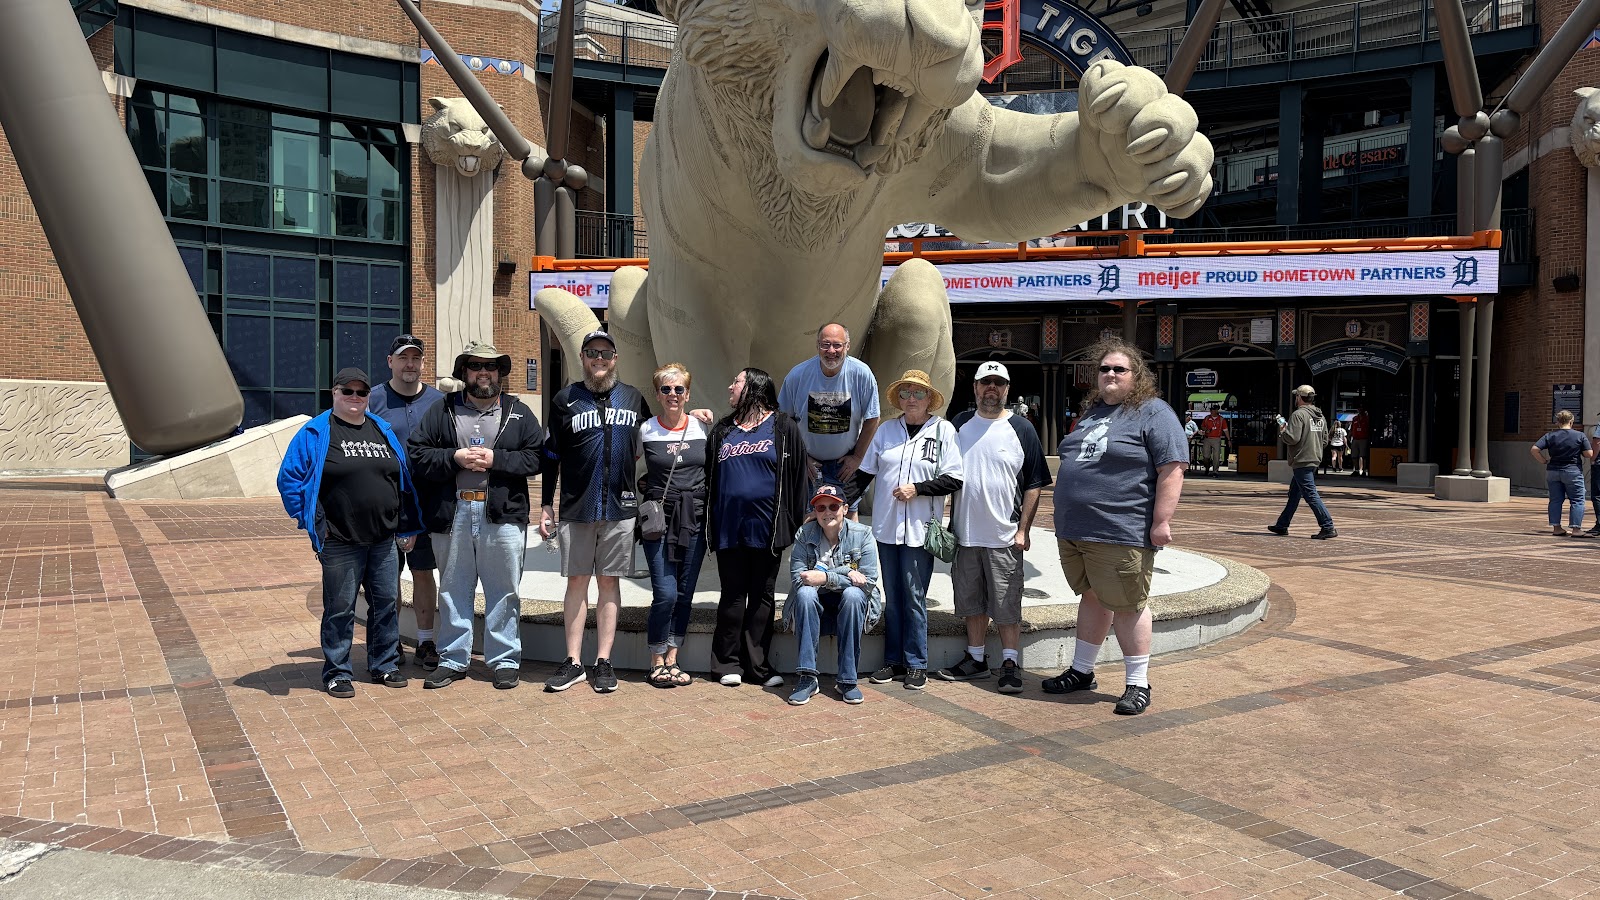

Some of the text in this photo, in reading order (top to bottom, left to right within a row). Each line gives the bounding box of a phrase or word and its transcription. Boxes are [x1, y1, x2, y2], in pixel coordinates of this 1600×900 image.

[1341, 147, 1397, 167] Caesars
[943, 276, 1013, 289] OMETOWN
[1017, 274, 1092, 288] PARTNERS
[1138, 266, 1201, 289] meijer
[1206, 270, 1258, 283] PROUD
[1262, 268, 1355, 282] HOMETOWN
[1360, 266, 1446, 281] PARTNERS
[987, 364, 998, 372] M
[616, 408, 638, 428] CITY
[344, 449, 391, 459] DETROIT
[718, 439, 773, 462] Detroit
